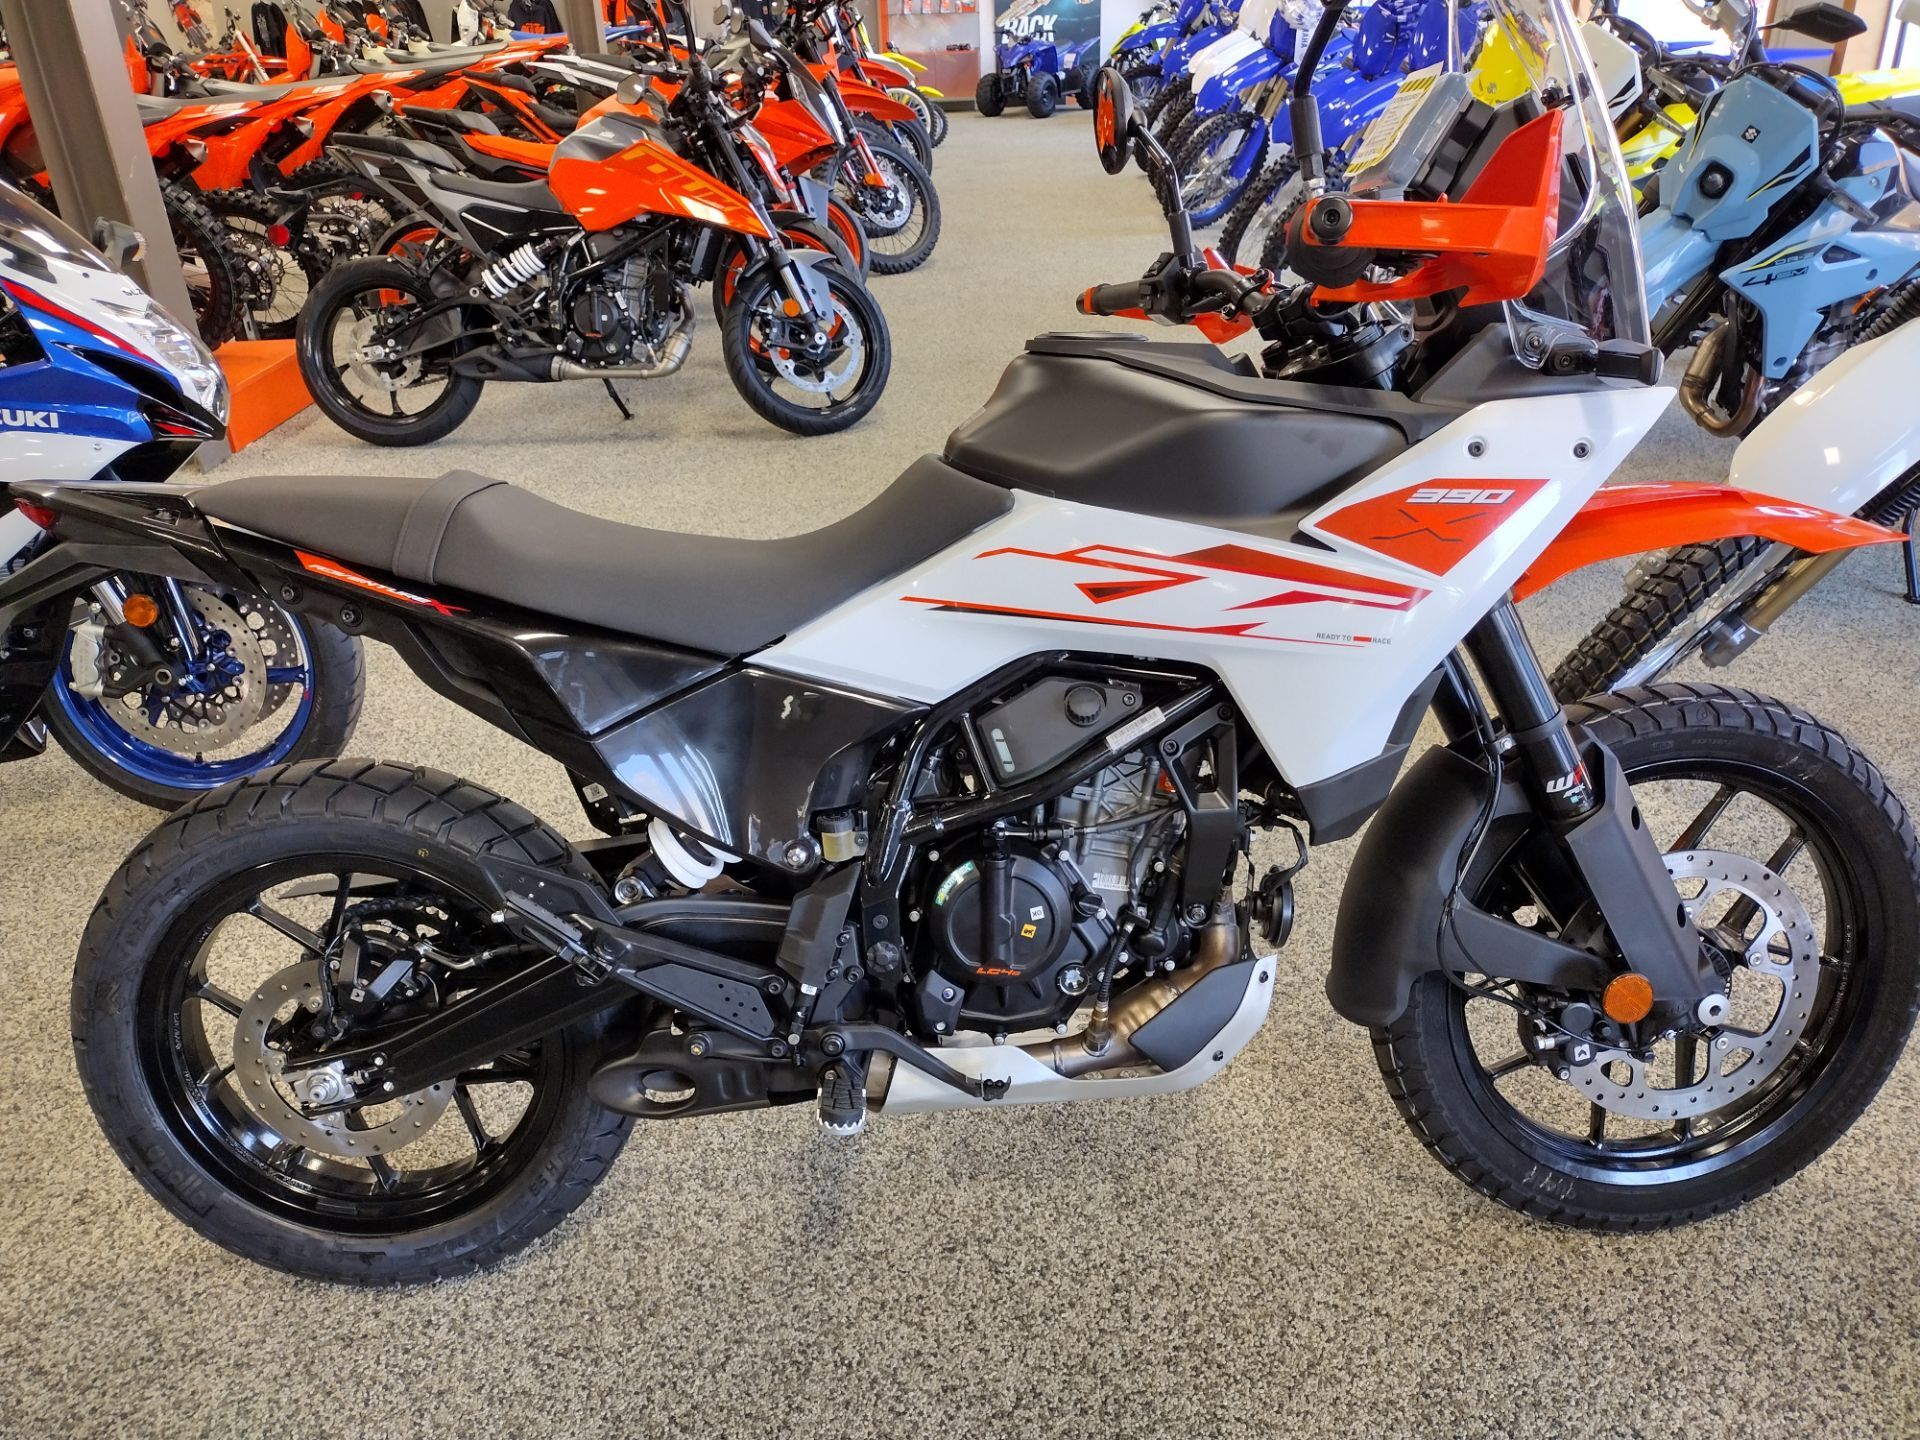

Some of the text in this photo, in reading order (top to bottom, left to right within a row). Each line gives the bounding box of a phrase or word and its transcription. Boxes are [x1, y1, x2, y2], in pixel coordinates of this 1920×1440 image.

[0, 408, 59, 428] UKI
[1405, 488, 1516, 504] 390
[1316, 631, 1392, 645] READY TO RACE
